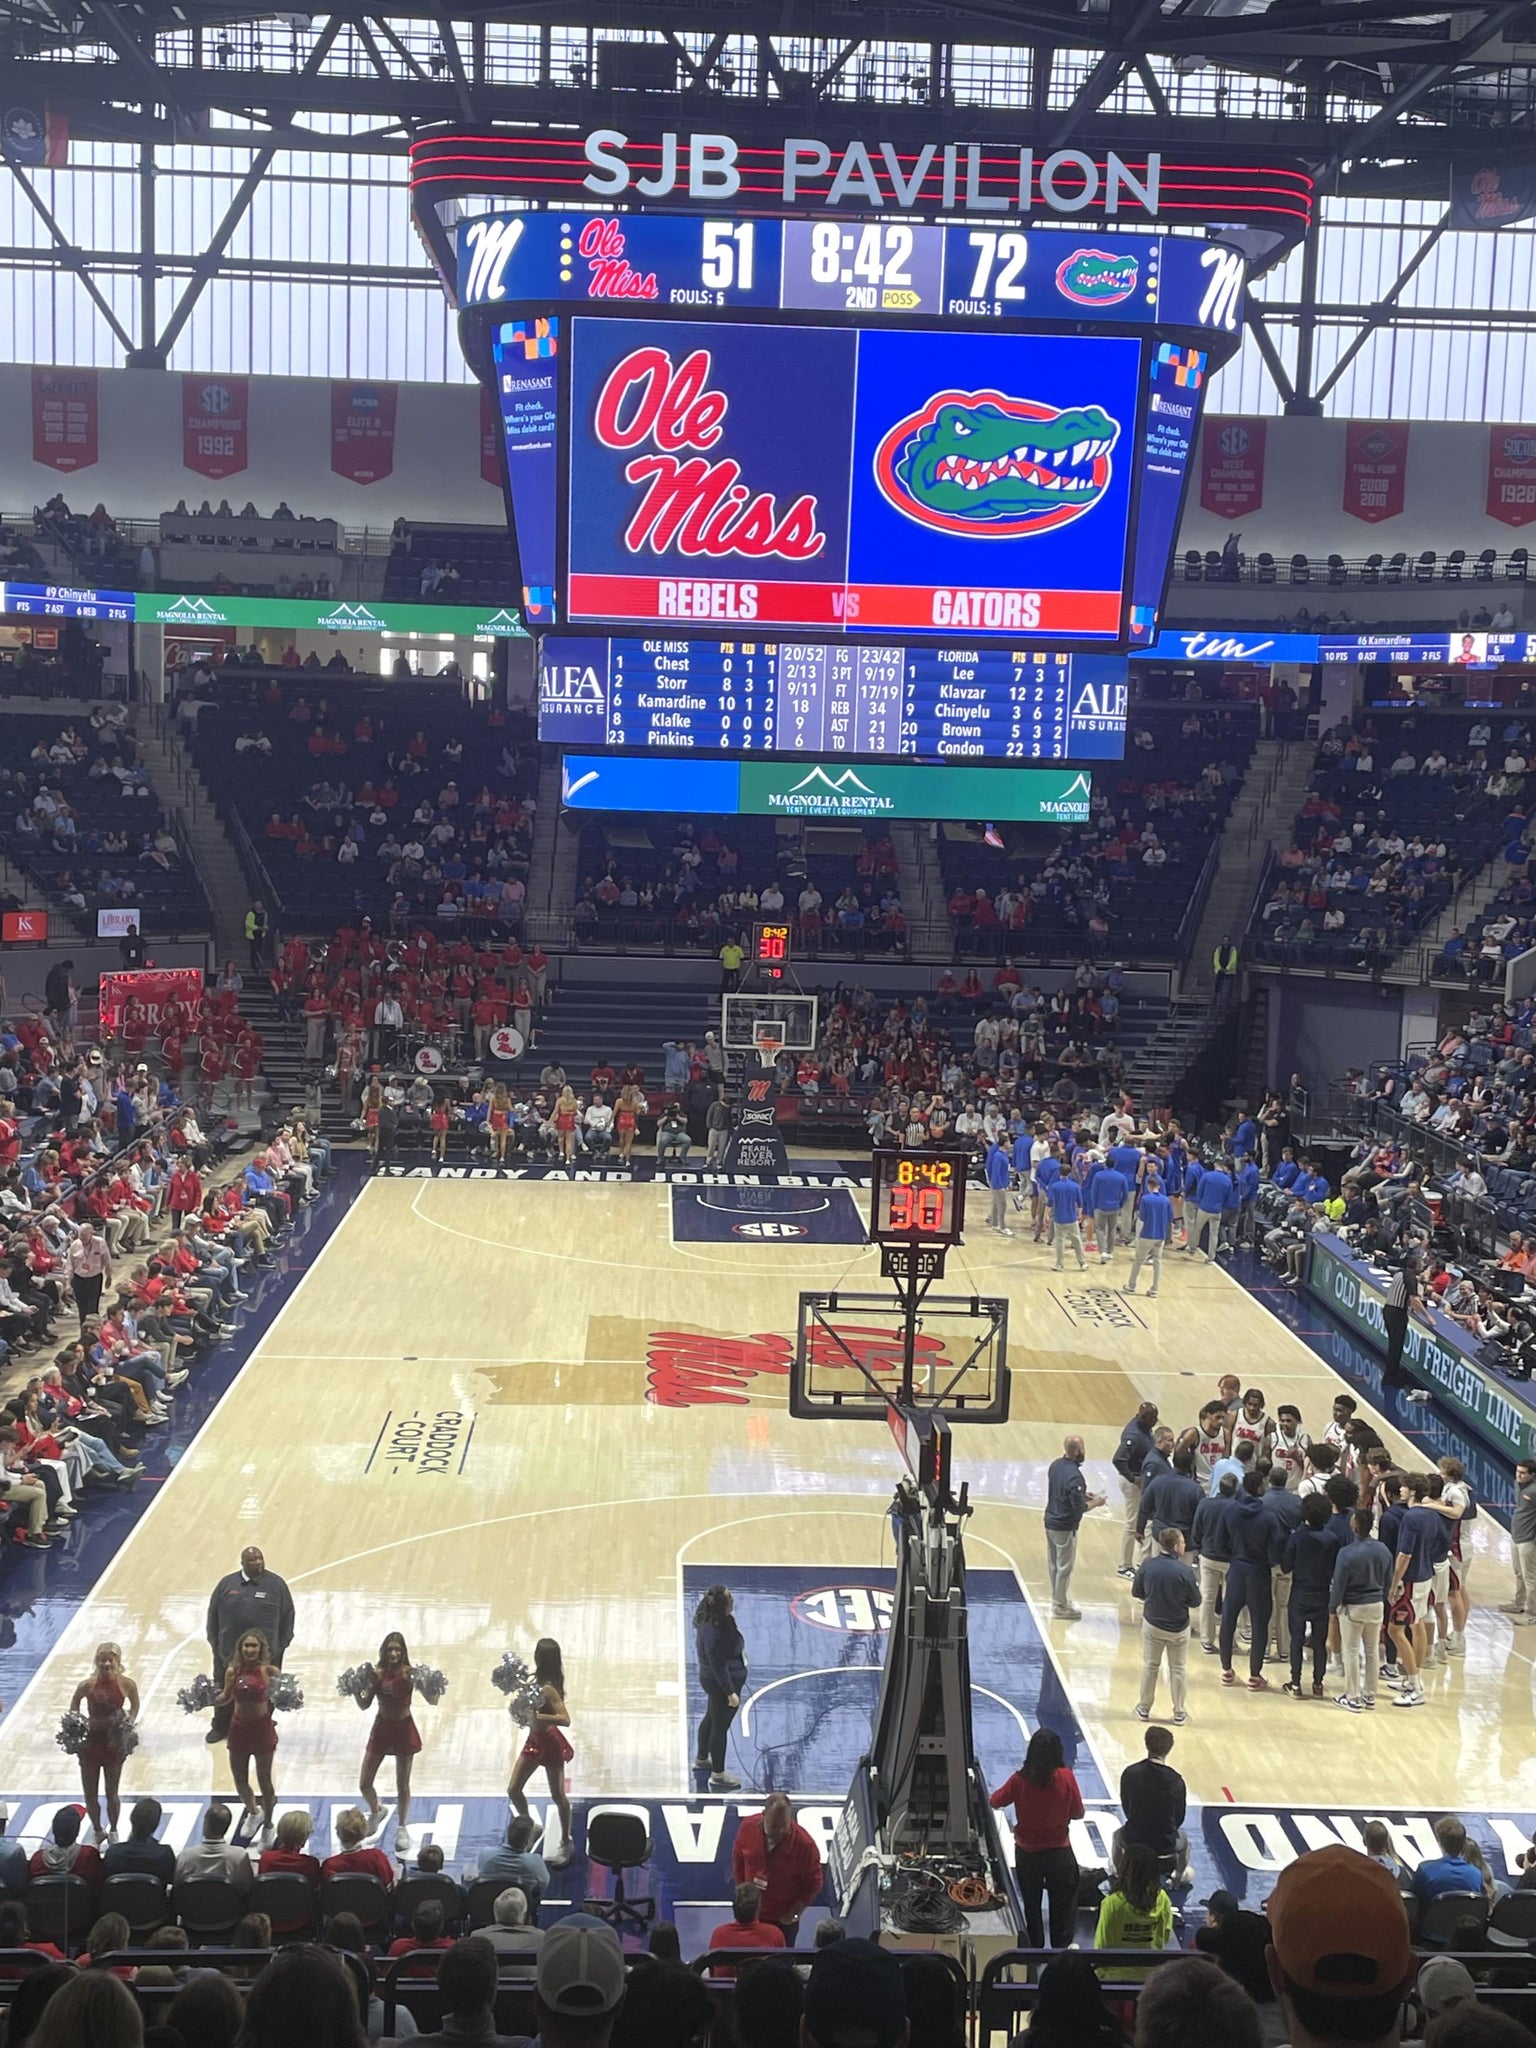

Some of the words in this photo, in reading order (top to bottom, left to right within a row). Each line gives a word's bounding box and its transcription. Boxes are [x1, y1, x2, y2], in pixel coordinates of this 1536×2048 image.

[583, 129, 741, 199] SJB
[781, 137, 1161, 216] PAVILION
[578, 218, 625, 258] Ole
[702, 222, 754, 289] 51
[811, 222, 913, 286] 8:42
[969, 232, 1028, 300] 72
[588, 257, 659, 299] Miss
[670, 288, 713, 305] FOULS:
[716, 292, 725, 306] 5
[845, 287, 877, 309] 2ND
[884, 292, 913, 305] POSS
[949, 300, 991, 315] FOULS:
[994, 303, 1002, 316] 5
[511, 376, 553, 391] RENASANT
[202, 384, 231, 414] SEC
[595, 347, 728, 452] Ole
[1159, 401, 1193, 419] RENASANT
[188, 418, 243, 431] CHAMPIONS
[347, 416, 372, 428] ELITE
[198, 435, 234, 456] 1992
[1221, 426, 1249, 455] SEC
[1360, 478, 1389, 493] 2008
[1501, 484, 1536, 504] 1928
[624, 454, 826, 560] Miss
[1360, 493, 1387, 507] 2010
[58, 588, 97, 602] Chinyelu
[658, 581, 758, 619] REBELS
[17, 602, 30, 612] PTS
[51, 604, 64, 614] AST
[83, 607, 97, 617] REB
[831, 592, 860, 618] VS
[932, 590, 1041, 628] GATORS
[114, 609, 127, 619] FLS
[156, 611, 196, 620] MAGNOLIA
[197, 613, 227, 621] RENTAL
[317, 617, 357, 626] MAGNOLIA
[357, 619, 387, 627] RENTAL
[643, 640, 661, 653] OLE
[663, 641, 689, 654] MISS
[1368, 636, 1412, 645] Kamardine
[784, 647, 824, 661] 20/52
[836, 649, 849, 663] FG
[861, 649, 900, 664] 23/42
[937, 651, 980, 664] FLORIDA
[1335, 652, 1348, 660] PTS
[1364, 651, 1377, 660] AST
[1395, 651, 1409, 660] REB
[1428, 651, 1442, 660] FLS
[1494, 645, 1500, 655] 5
[654, 656, 690, 671] Chest
[723, 659, 732, 672] 0
[787, 664, 816, 679] 2/13
[840, 667, 852, 681] PT
[864, 667, 895, 682] 9/19
[953, 666, 975, 680] Lee
[1014, 668, 1023, 682] 7
[1035, 669, 1044, 682] 3
[541, 666, 605, 698] ALFA
[614, 674, 623, 687] 2
[656, 675, 688, 690] Storr
[722, 677, 732, 691] 8
[745, 678, 754, 692] 3
[787, 682, 817, 696] 9/11
[835, 684, 847, 698] FT
[861, 685, 899, 700] 17/19
[907, 684, 916, 697] 7
[940, 685, 986, 700] Klavzar
[1009, 687, 1026, 701] 12
[1034, 688, 1044, 701] 2
[1055, 688, 1065, 702] 2
[613, 694, 622, 706] 6
[638, 694, 707, 710] Kamardine
[718, 697, 736, 710] 10
[765, 698, 774, 712] 2
[792, 700, 809, 713] 18
[831, 701, 850, 715] REB
[868, 702, 886, 715] 34
[906, 703, 915, 716] 9
[935, 703, 990, 721] Chinyelu
[1012, 706, 1021, 719] 3
[1033, 707, 1042, 720] 6
[1054, 707, 1063, 721] 2
[613, 712, 622, 725] 8
[651, 713, 691, 728] Klafke
[721, 716, 731, 729] 0
[743, 716, 752, 730] 0
[764, 717, 773, 731] 0
[795, 716, 804, 730] 9
[830, 718, 849, 732] AST
[869, 720, 885, 734] 21
[901, 722, 918, 735] 20
[942, 723, 981, 737] Brown
[1011, 725, 1020, 738] 5
[608, 731, 625, 744] 23
[648, 731, 694, 747] Pinkins
[720, 734, 729, 748] 6
[742, 735, 751, 748] 2
[764, 735, 773, 749] 2
[795, 733, 804, 747] 6
[832, 735, 846, 750] TO
[868, 737, 885, 750] 13
[901, 740, 916, 753] 21
[937, 740, 984, 755] Condon
[1006, 742, 1024, 756] 22
[768, 794, 839, 807] MAGNOLIA
[841, 796, 894, 809] RENTAL
[786, 806, 804, 814] TENT
[809, 806, 831, 814] EVENT
[837, 808, 877, 816] EQUIPMENT
[102, 913, 136, 926] LIBRARY
[762, 927, 788, 940] 8:42
[759, 939, 785, 958] 30
[748, 1080, 772, 1101] M
[745, 1112, 770, 1121] SONIC
[737, 1158, 777, 1167] RESORT
[740, 1151, 773, 1159] RIVER
[376, 1166, 528, 1179] SANDY
[542, 1170, 632, 1182] AND
[650, 1172, 760, 1185] JOHN
[898, 1160, 951, 1186] 8:42
[890, 1187, 944, 1231] 30
[738, 1223, 799, 1236] SEC
[1334, 1272, 1356, 1308] OLD
[1424, 1339, 1484, 1413] FREIGHT
[1485, 1389, 1524, 1446] LINE
[385, 1420, 427, 1463] COURT
[416, 1411, 464, 1474] CRADDOCK
